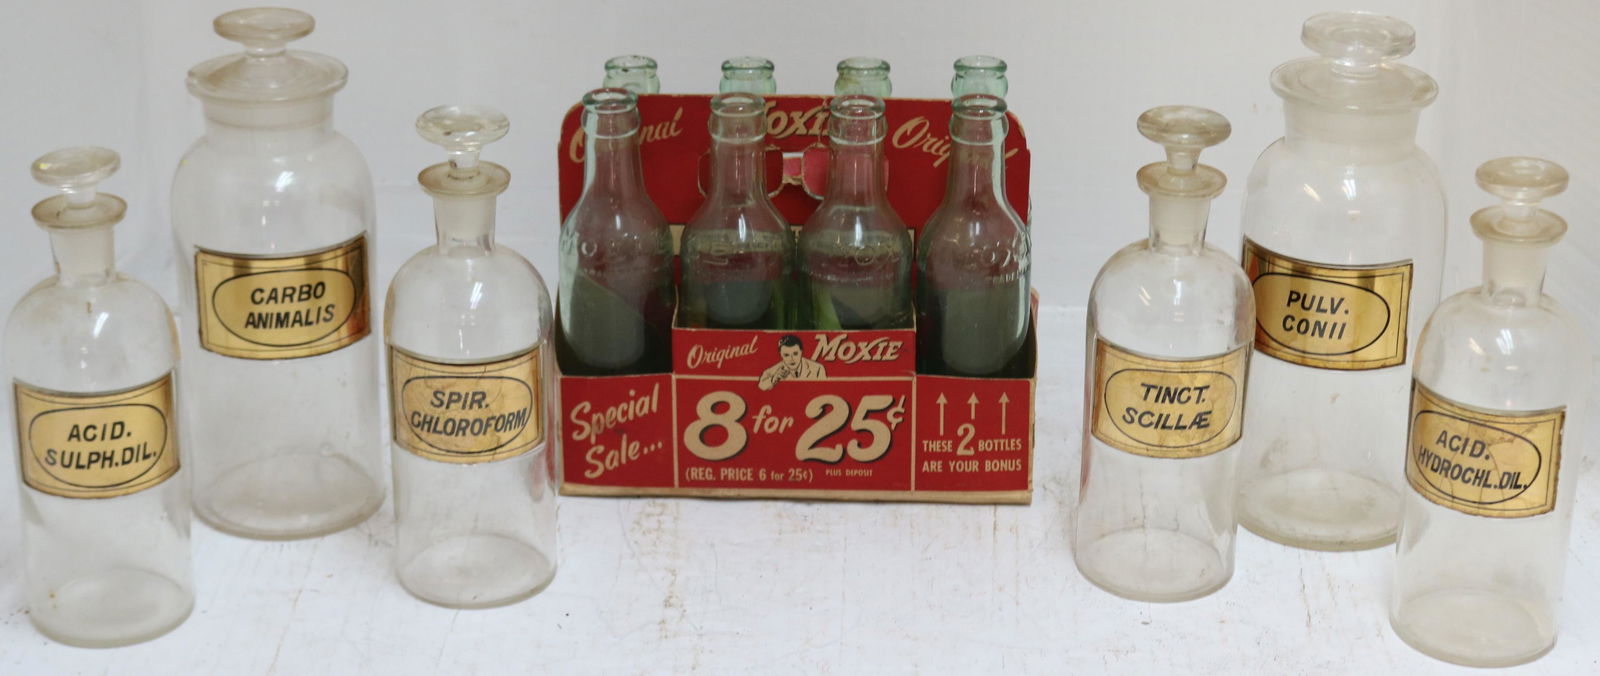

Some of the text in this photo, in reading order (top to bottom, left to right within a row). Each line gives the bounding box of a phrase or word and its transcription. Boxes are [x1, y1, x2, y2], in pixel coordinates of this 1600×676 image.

[251, 281, 325, 305] CARBO
[1287, 290, 1349, 315] PULV.
[245, 304, 335, 329] ANIMALIS
[1282, 314, 1347, 340] CONII
[687, 336, 757, 369] Original
[431, 390, 489, 410] SPIR.
[1141, 383, 1210, 405] TINCT.
[570, 382, 660, 444] Special
[1122, 407, 1212, 431] SCILLÆ
[67, 421, 132, 442] ACID.
[684, 391, 906, 464] 8 for 25¢
[922, 423, 1022, 456] THESE 2 BOTTLES
[45, 442, 156, 470] SULPH.DIL.
[584, 433, 663, 479] Sale...
[1436, 430, 1490, 460] ACID.
[685, 467, 813, 483] (REG. PRICE 6 for 25¢)
[825, 468, 873, 477] PLUS DEPOSIT
[922, 459, 1022, 473] ARE YOUR BONUS
